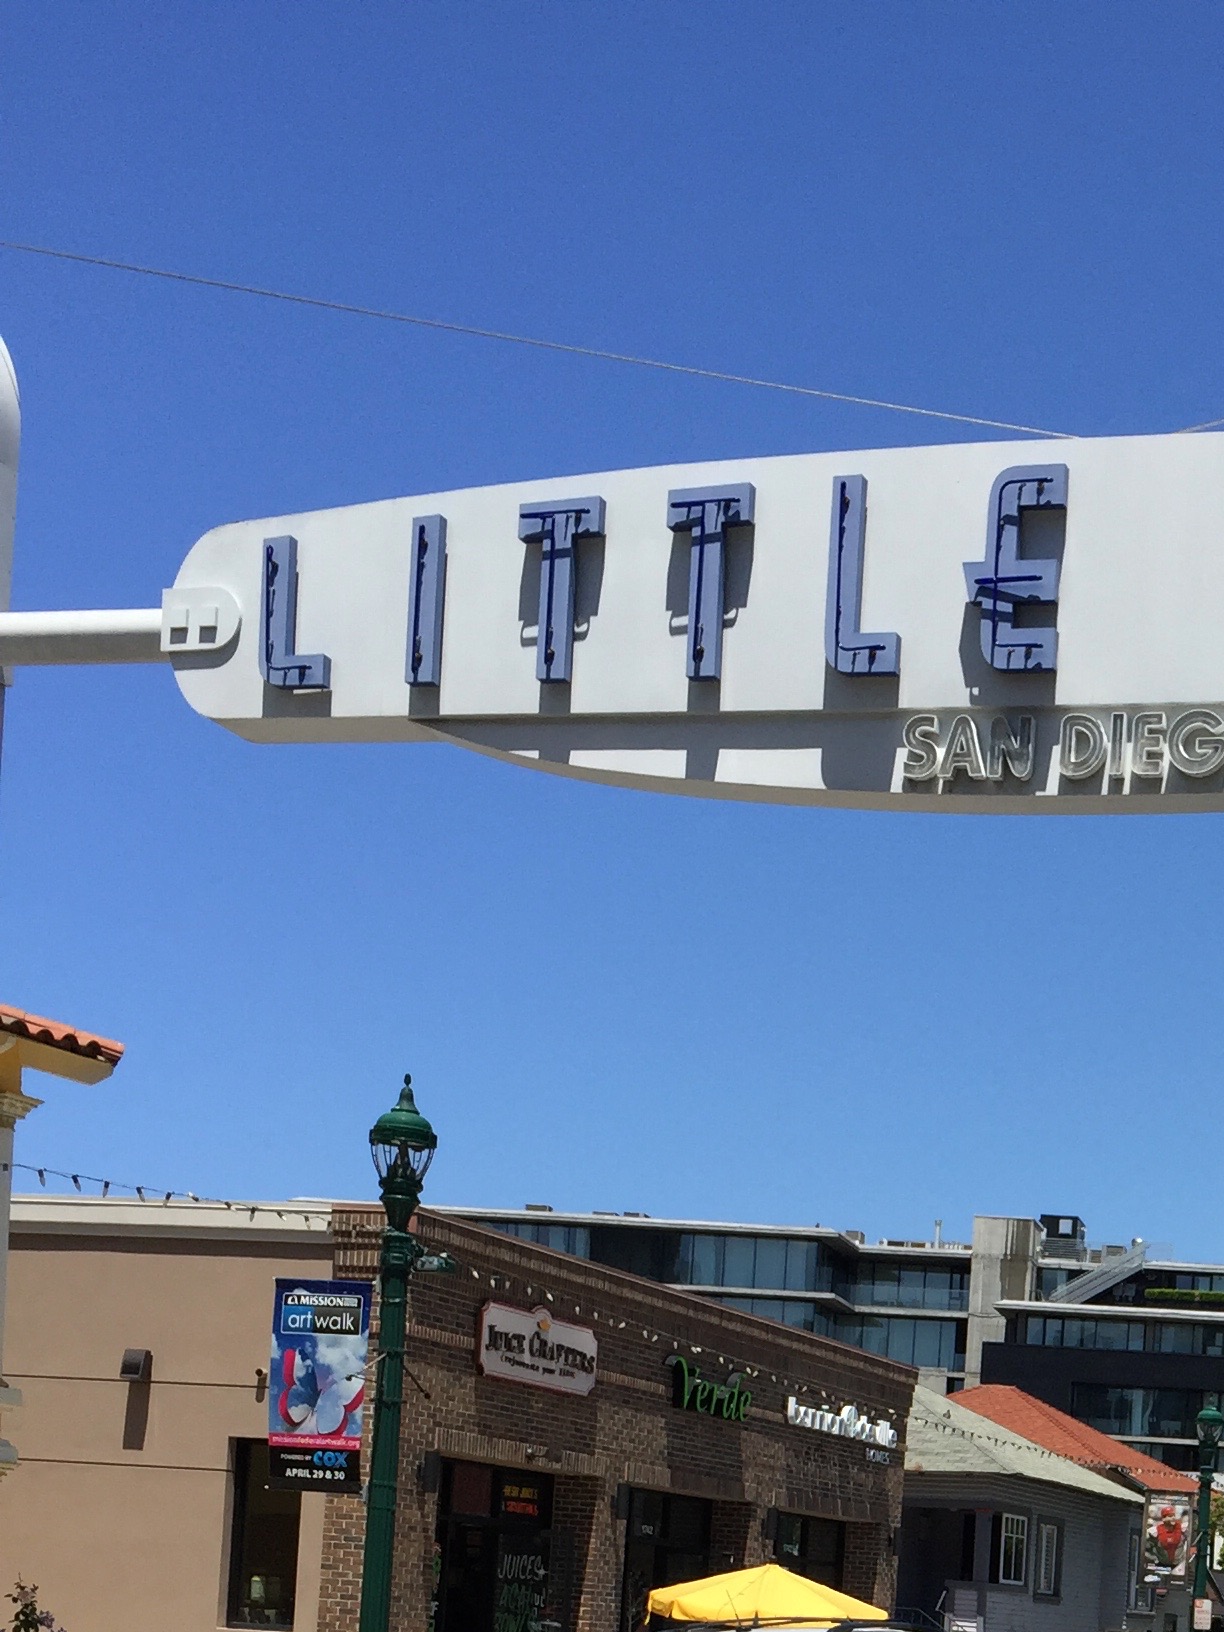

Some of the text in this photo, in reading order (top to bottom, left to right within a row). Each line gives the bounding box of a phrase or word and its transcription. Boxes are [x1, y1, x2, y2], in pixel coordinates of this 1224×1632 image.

[262, 463, 1069, 690] LITTLE
[902, 713, 1036, 781] SAN
[299, 1294, 345, 1307] MISSION
[485, 1324, 526, 1354] JUICE
[664, 1354, 752, 1422] Verde
[285, 1467, 346, 1480] APRIL 29 & 30
[313, 1450, 349, 1469] COX
